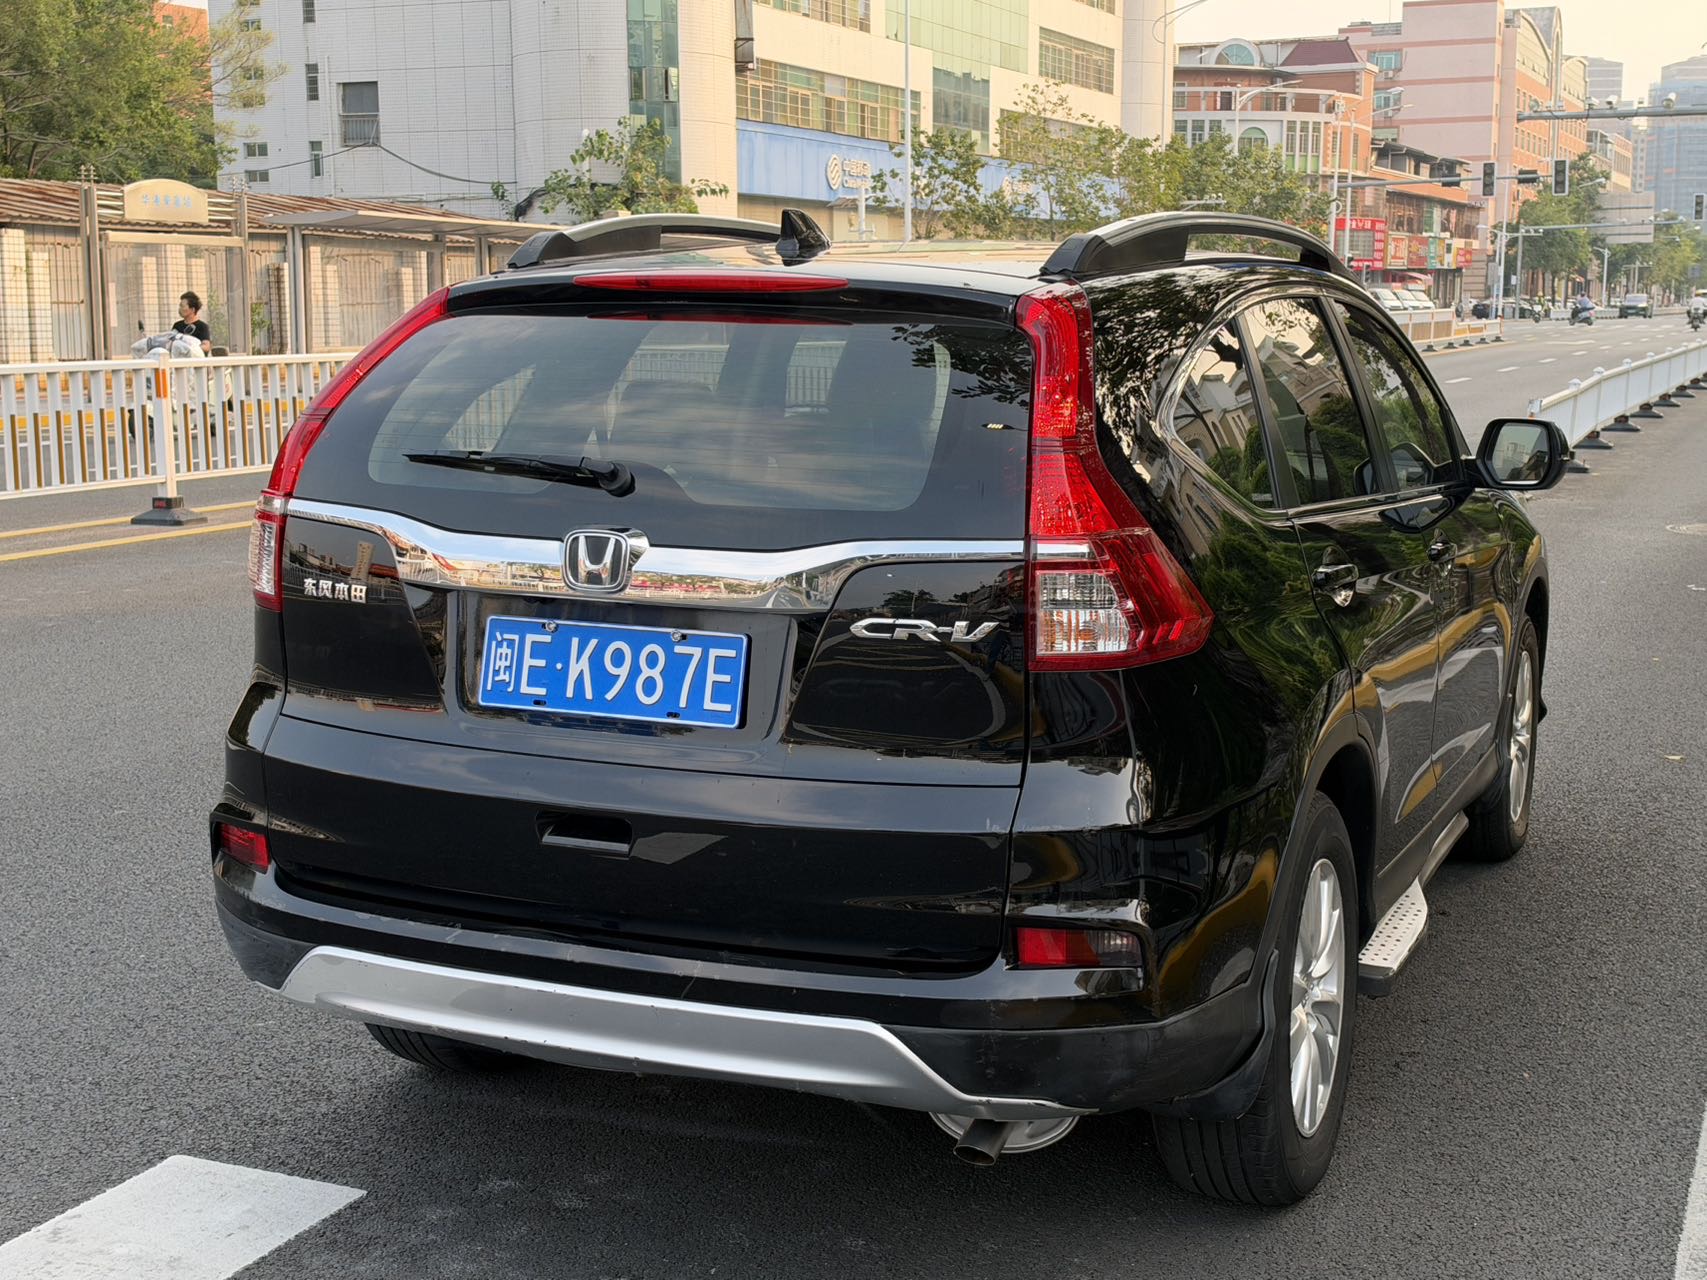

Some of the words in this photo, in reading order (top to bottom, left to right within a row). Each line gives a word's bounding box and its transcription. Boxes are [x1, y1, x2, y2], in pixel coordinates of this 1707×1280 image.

[303, 578, 368, 604] 东风本田
[849, 617, 1000, 643] CR-V
